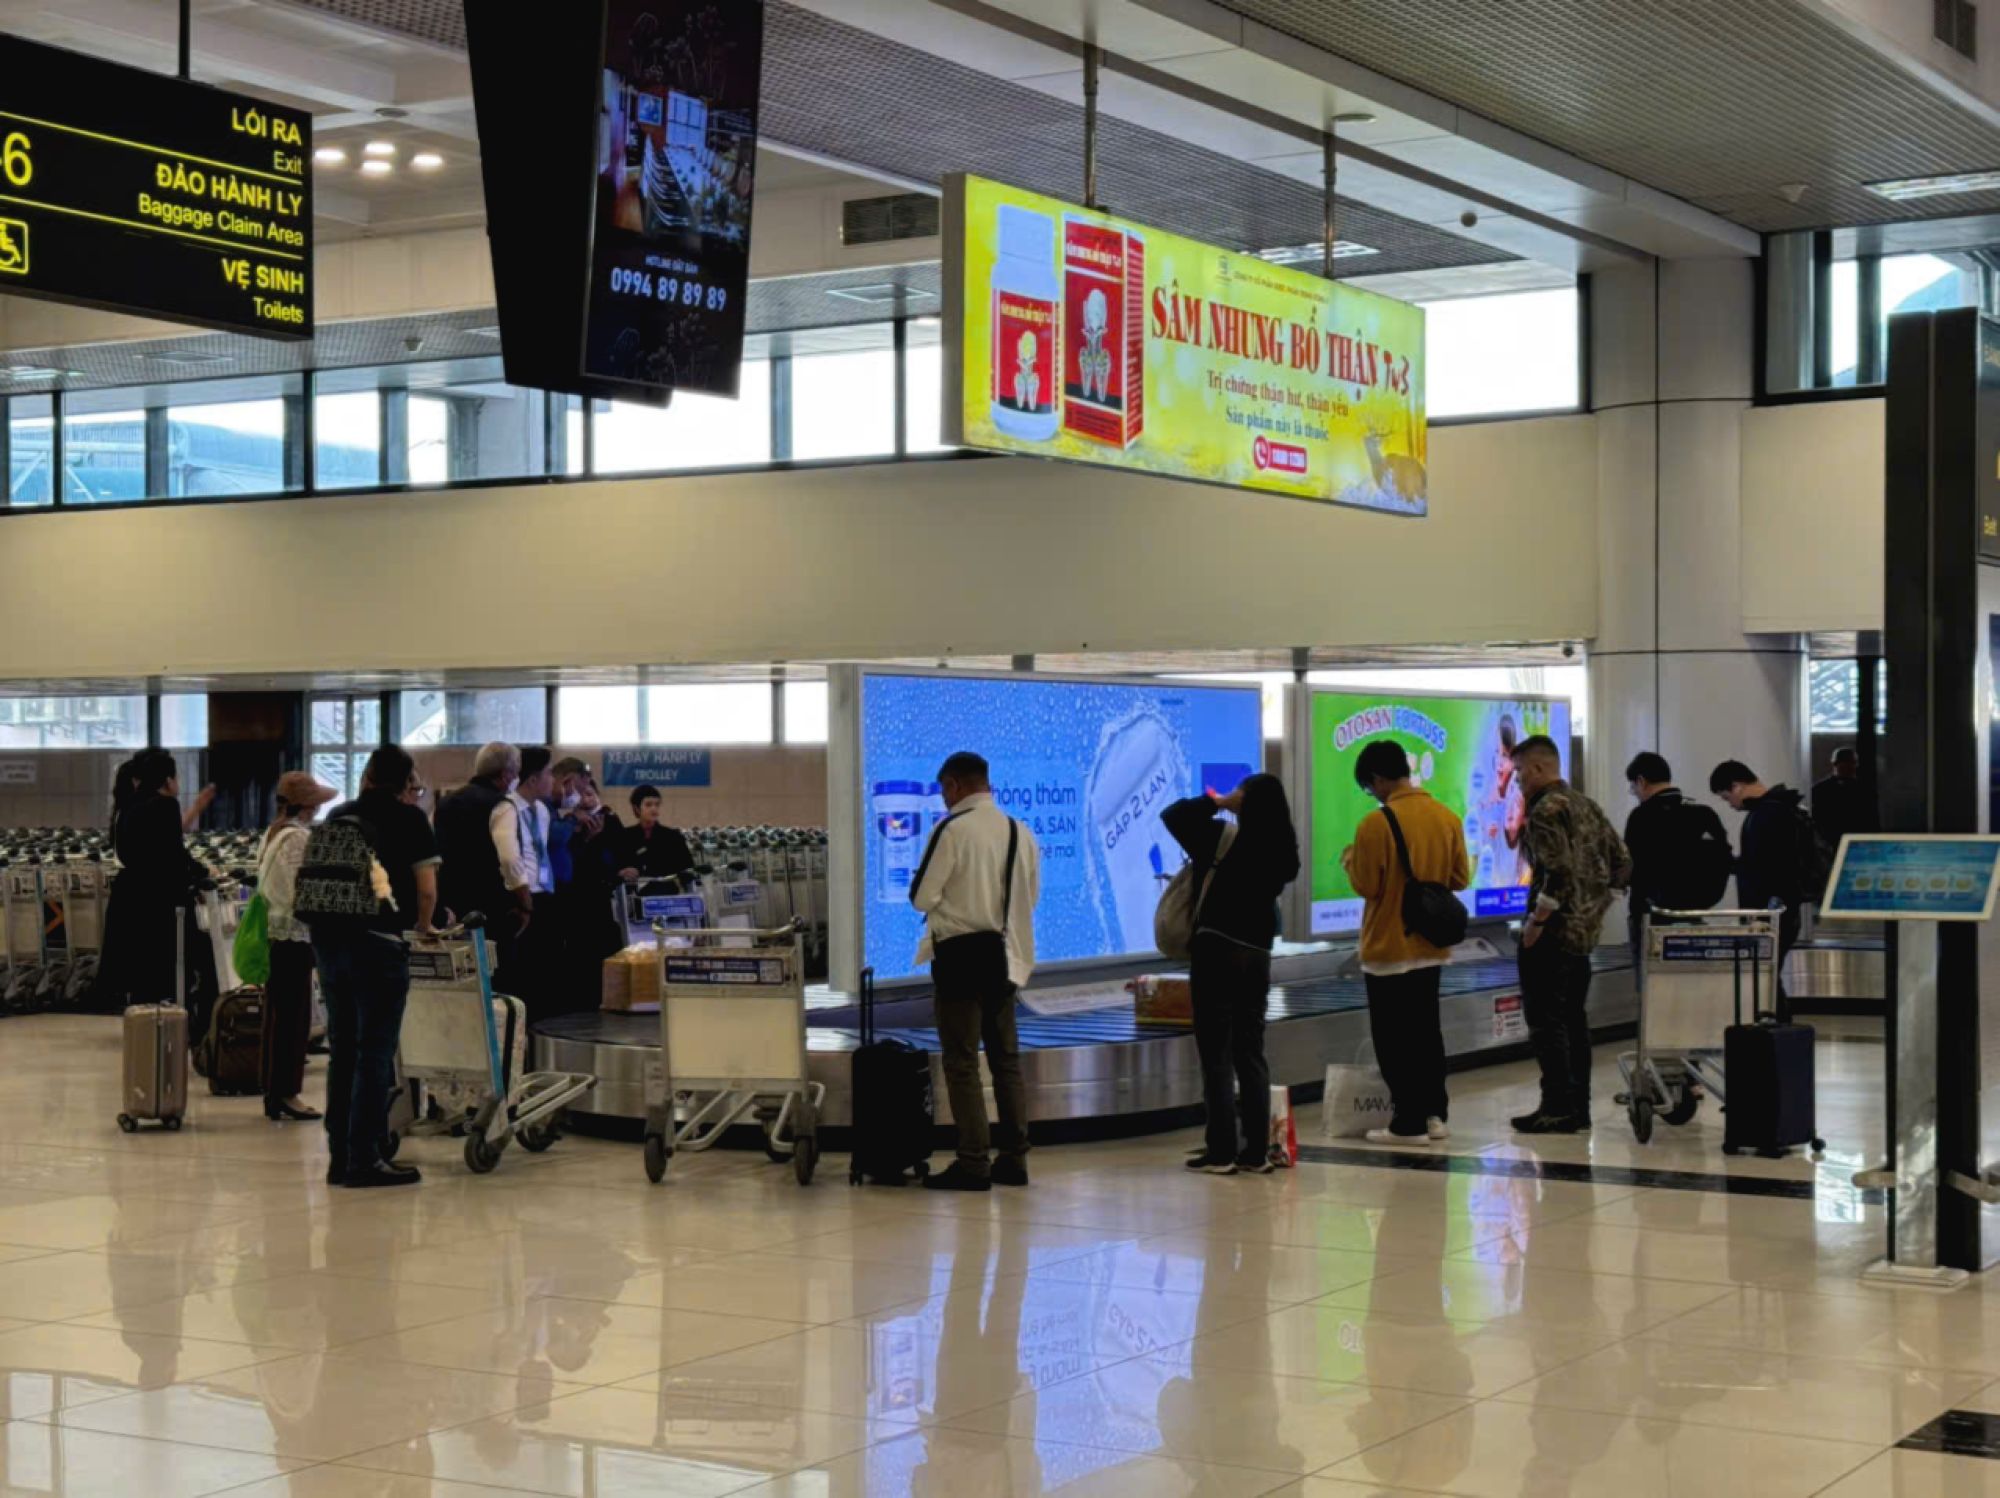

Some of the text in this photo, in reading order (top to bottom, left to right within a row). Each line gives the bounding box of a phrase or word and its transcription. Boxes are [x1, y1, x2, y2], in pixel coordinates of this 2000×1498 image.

[273, 118, 302, 146] RA
[273, 150, 303, 175] Exit
[138, 193, 304, 246] Baggage Claim Area
[256, 264, 304, 295] SINH
[611, 267, 727, 312] 0994 89 89 89
[253, 295, 305, 324] Toilets
[1206, 301, 1284, 366] NHUNG
[1335, 706, 1393, 751] OTOSAN
[634, 767, 679, 780] TROLLEY
[1130, 795, 1143, 819] 2
[1034, 816, 1044, 834] &
